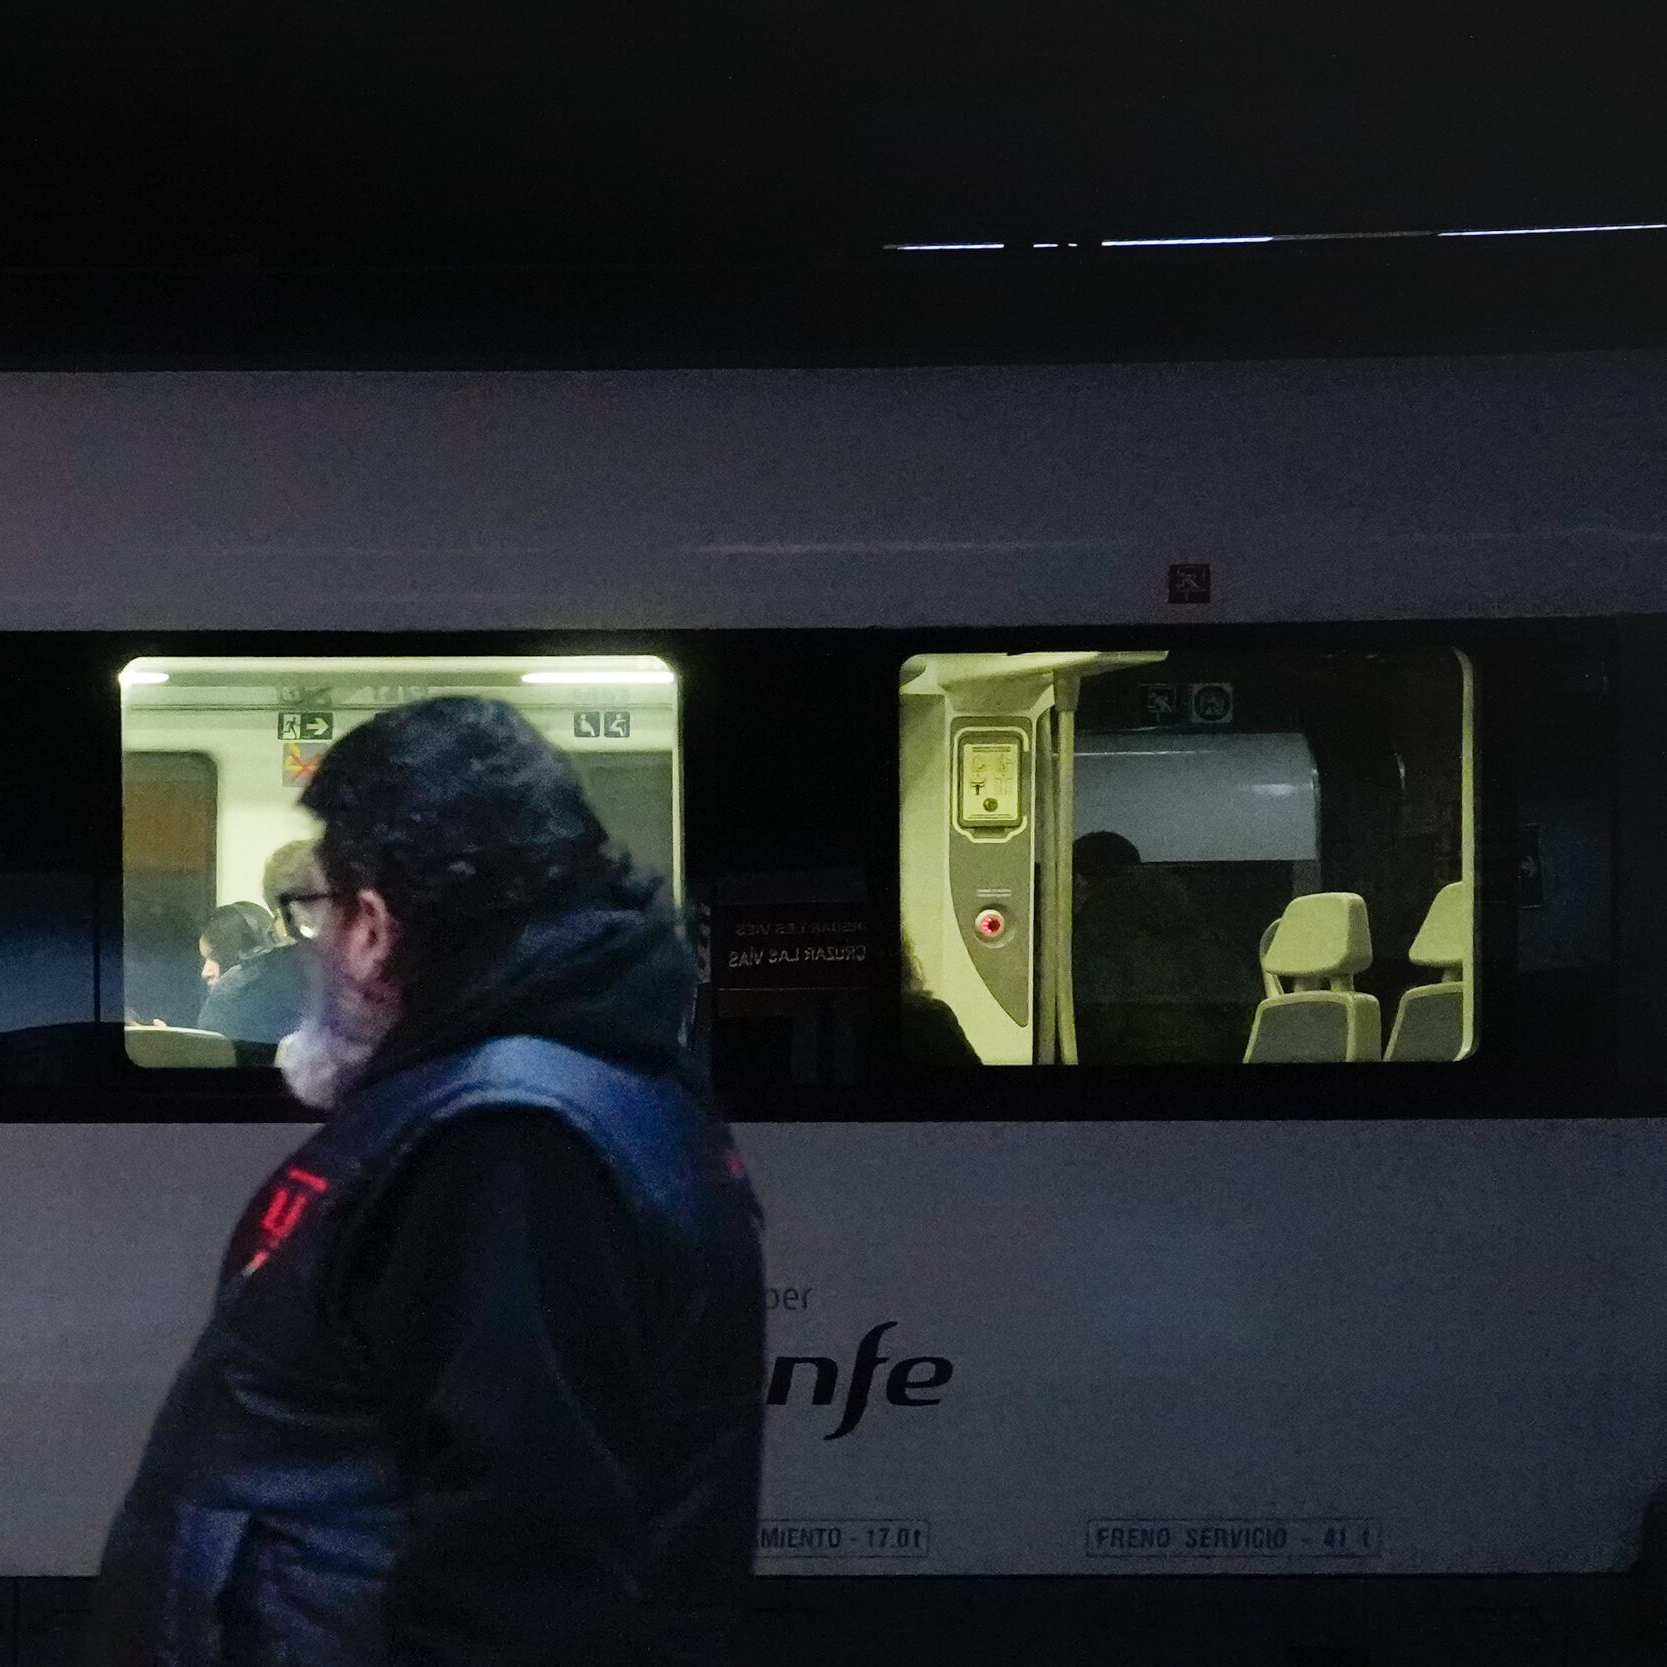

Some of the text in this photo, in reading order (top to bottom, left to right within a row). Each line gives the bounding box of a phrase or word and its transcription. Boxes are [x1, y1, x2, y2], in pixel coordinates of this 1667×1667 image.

[767, 1320, 954, 1441] nfe
[758, 1527, 842, 1549] MIENTO
[1096, 1527, 1171, 1549] FRENO
[1185, 1527, 1287, 1549] SERVICIO
